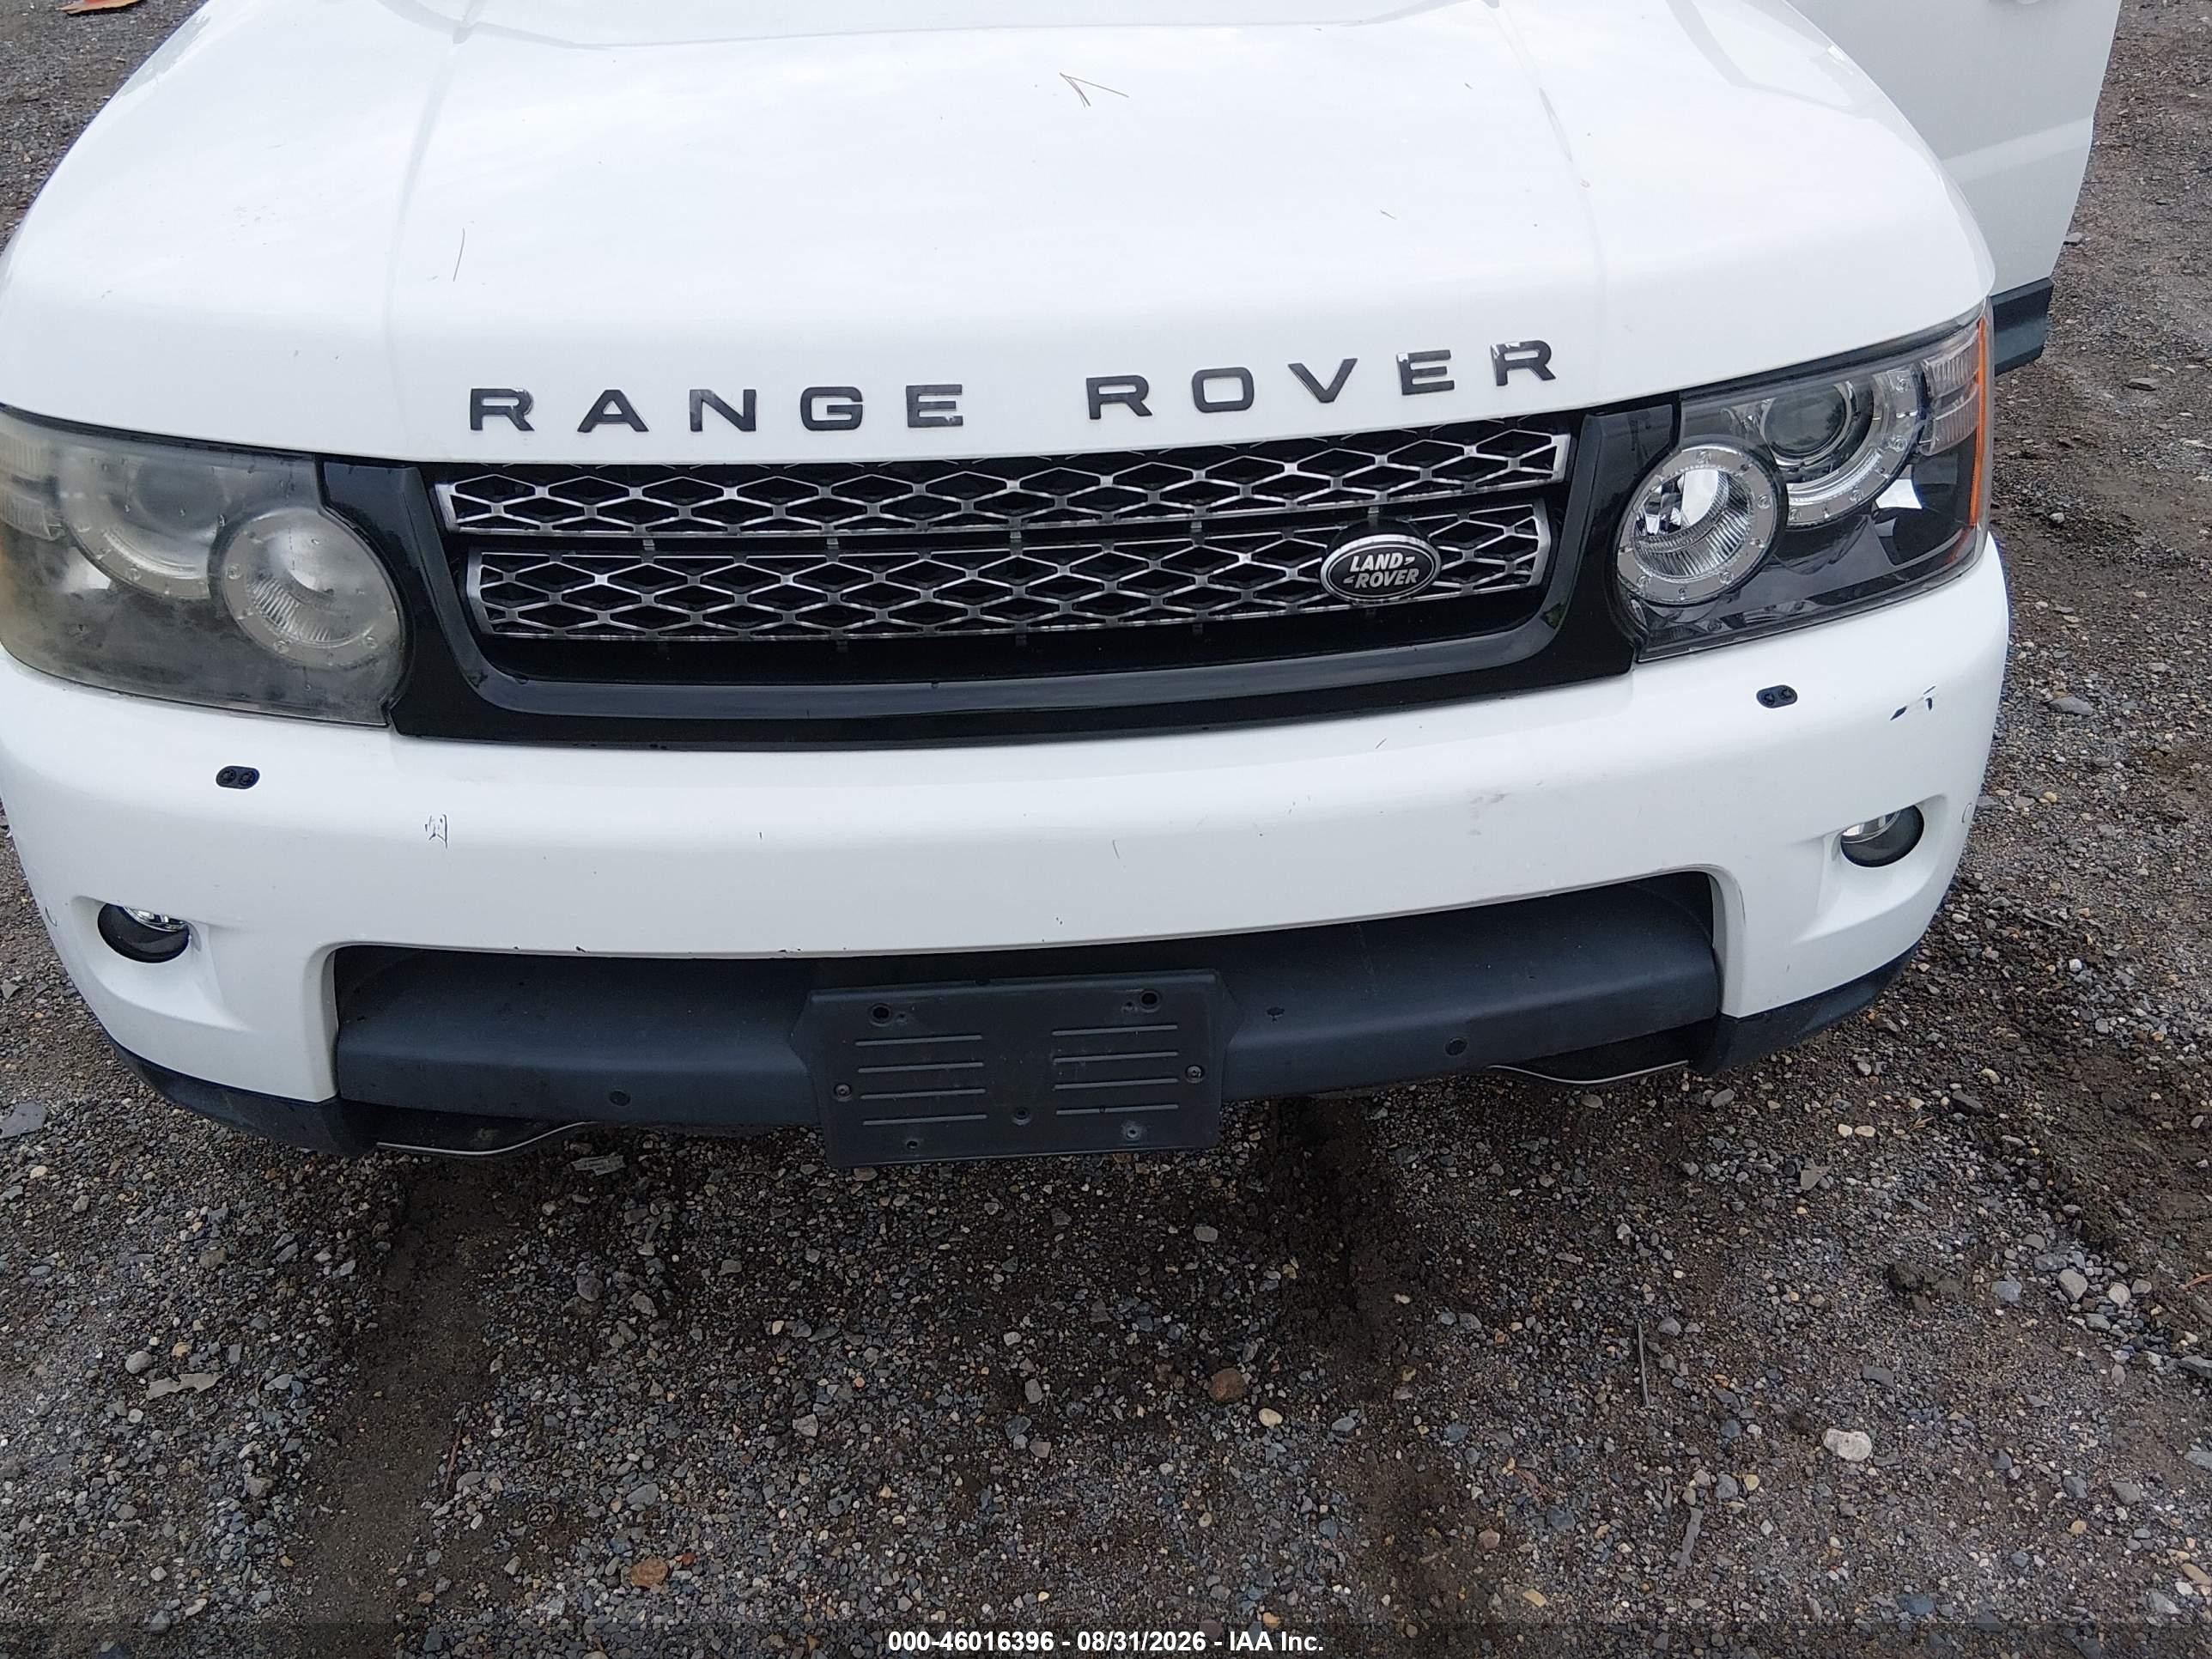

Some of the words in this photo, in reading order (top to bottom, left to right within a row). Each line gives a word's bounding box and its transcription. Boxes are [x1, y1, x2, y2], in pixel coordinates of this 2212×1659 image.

[470, 386, 964, 433] RANGE
[1085, 339, 1556, 420] ROVER
[1354, 568, 1419, 589] ROVER
